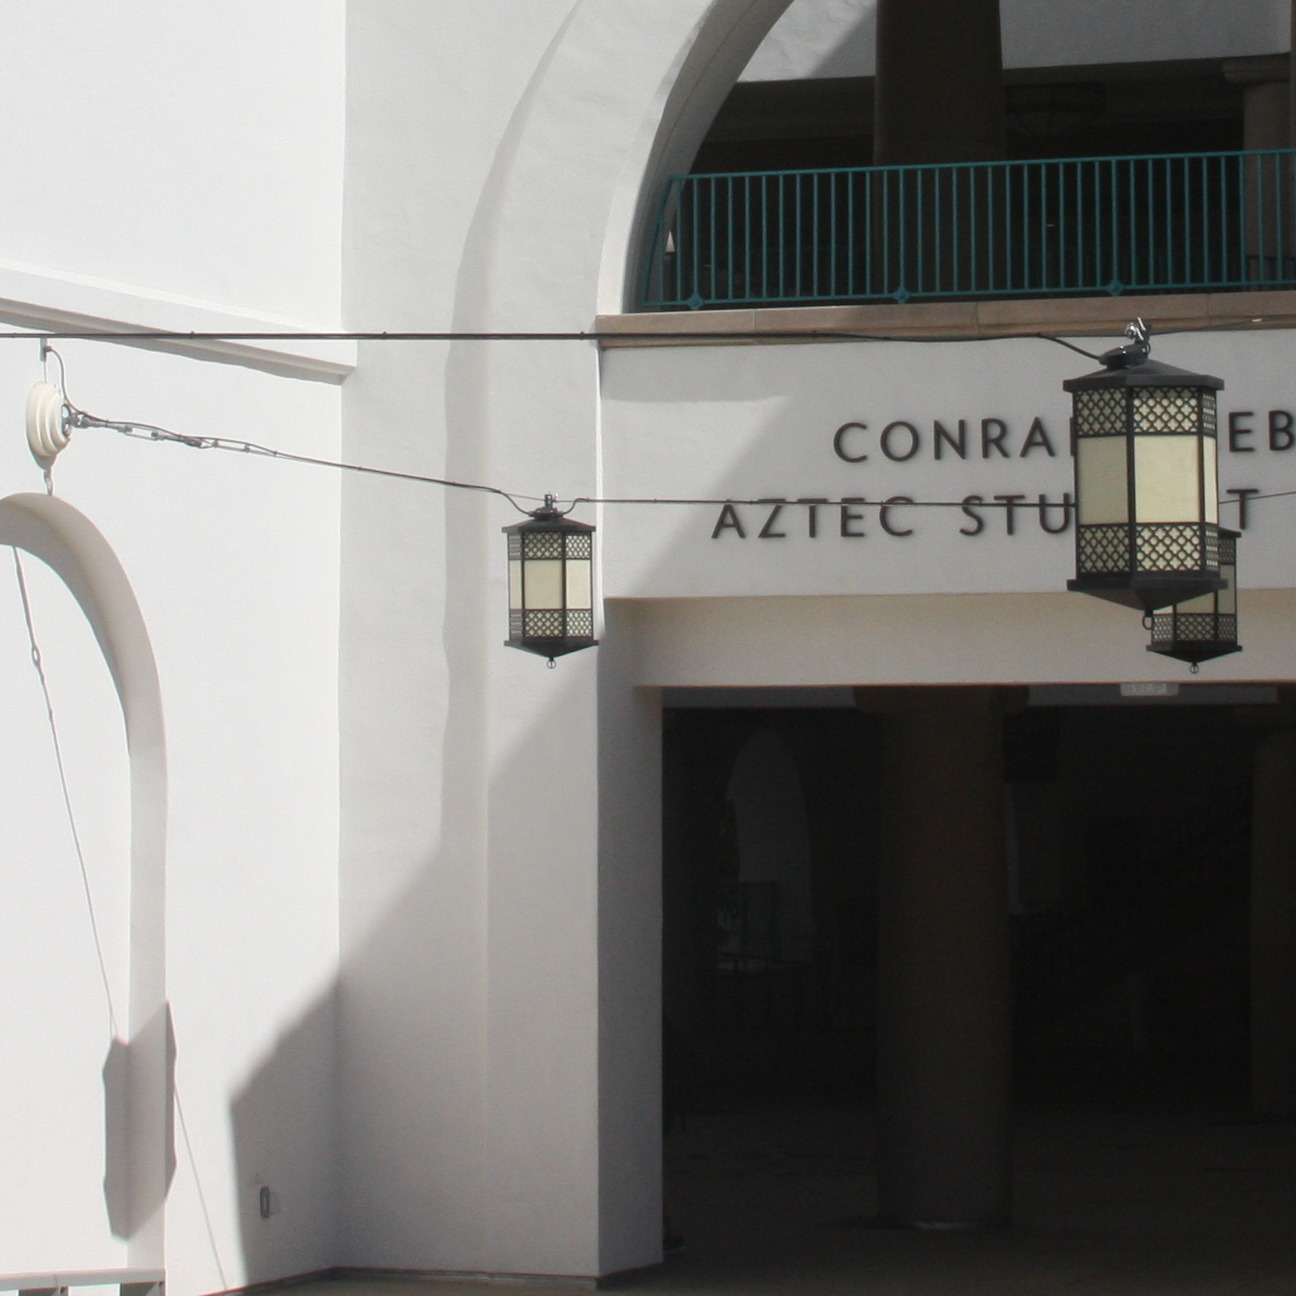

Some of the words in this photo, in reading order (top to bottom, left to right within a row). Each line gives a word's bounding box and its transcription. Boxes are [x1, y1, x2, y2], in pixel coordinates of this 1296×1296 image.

[833, 416, 1076, 463] CONRA
[711, 497, 914, 539] AZTEC
[959, 490, 1260, 537] STUT
